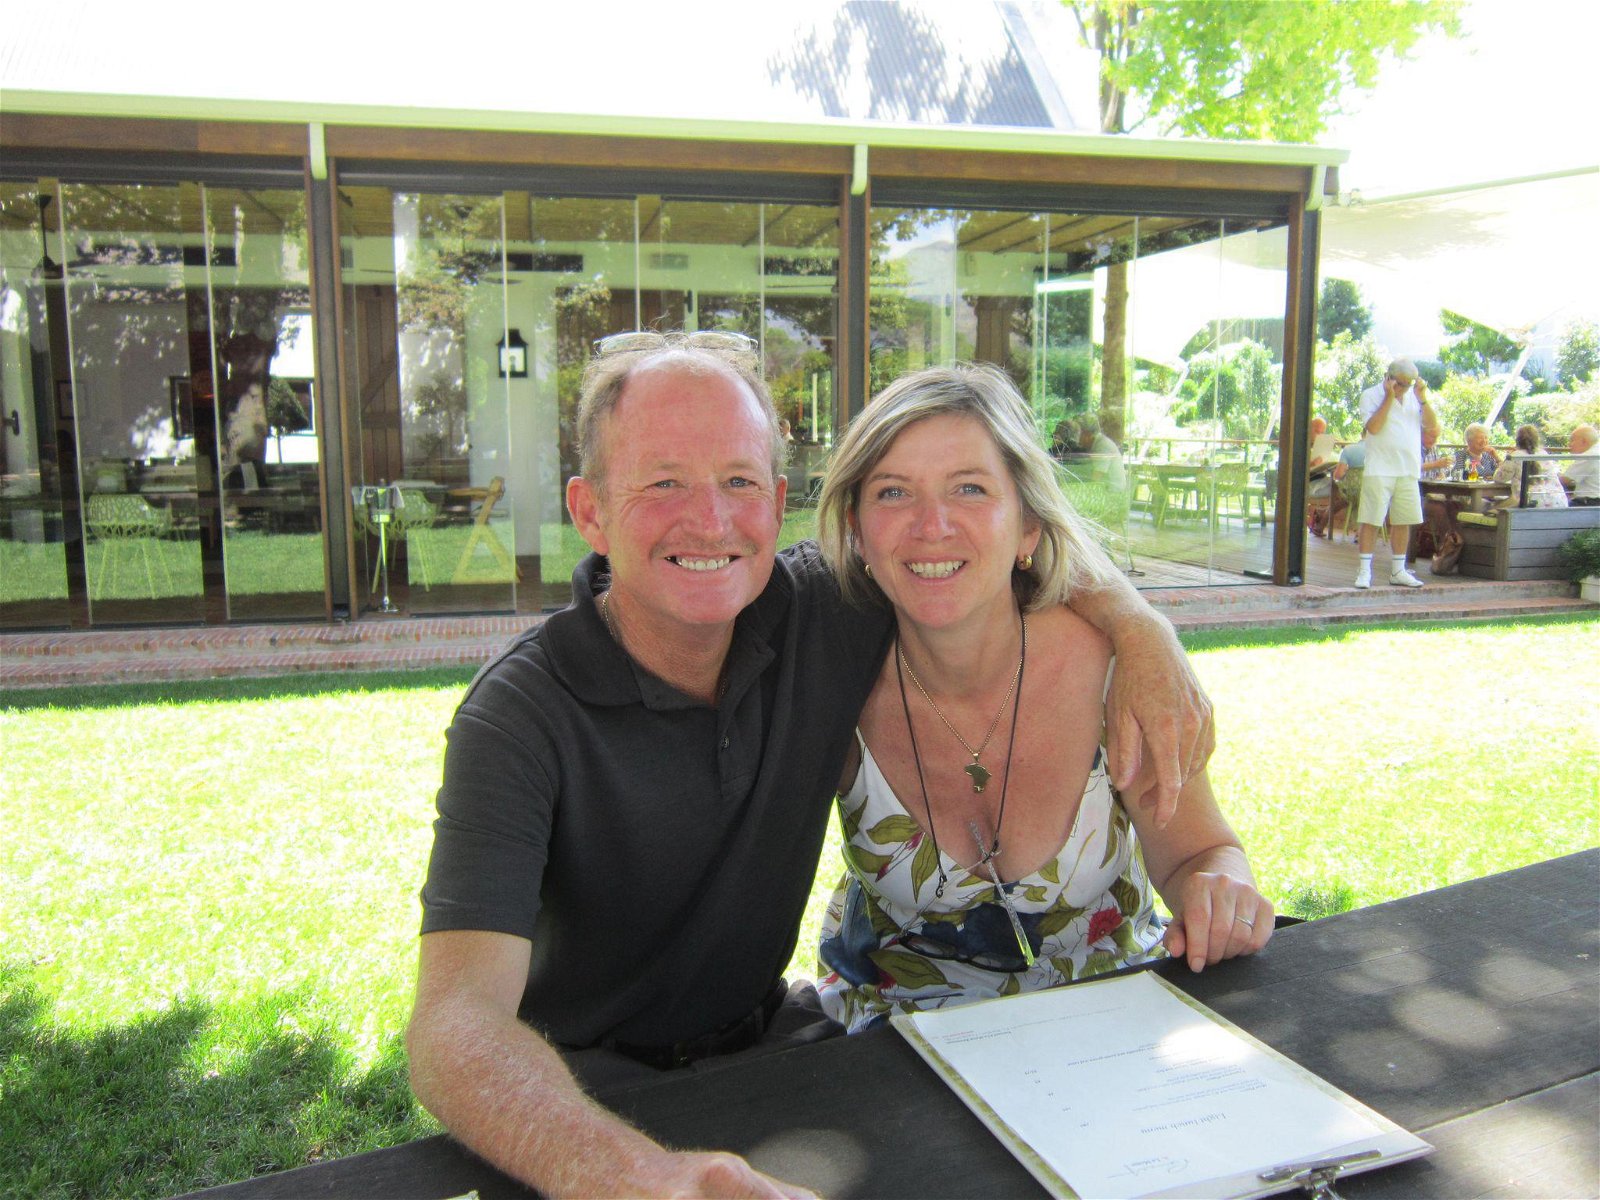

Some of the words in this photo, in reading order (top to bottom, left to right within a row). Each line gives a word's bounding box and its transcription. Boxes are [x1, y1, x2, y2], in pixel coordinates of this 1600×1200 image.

[1200, 1112, 1226, 1123] Light
[1171, 1119, 1199, 1129] lunch
[1140, 1125, 1168, 1134] menu
